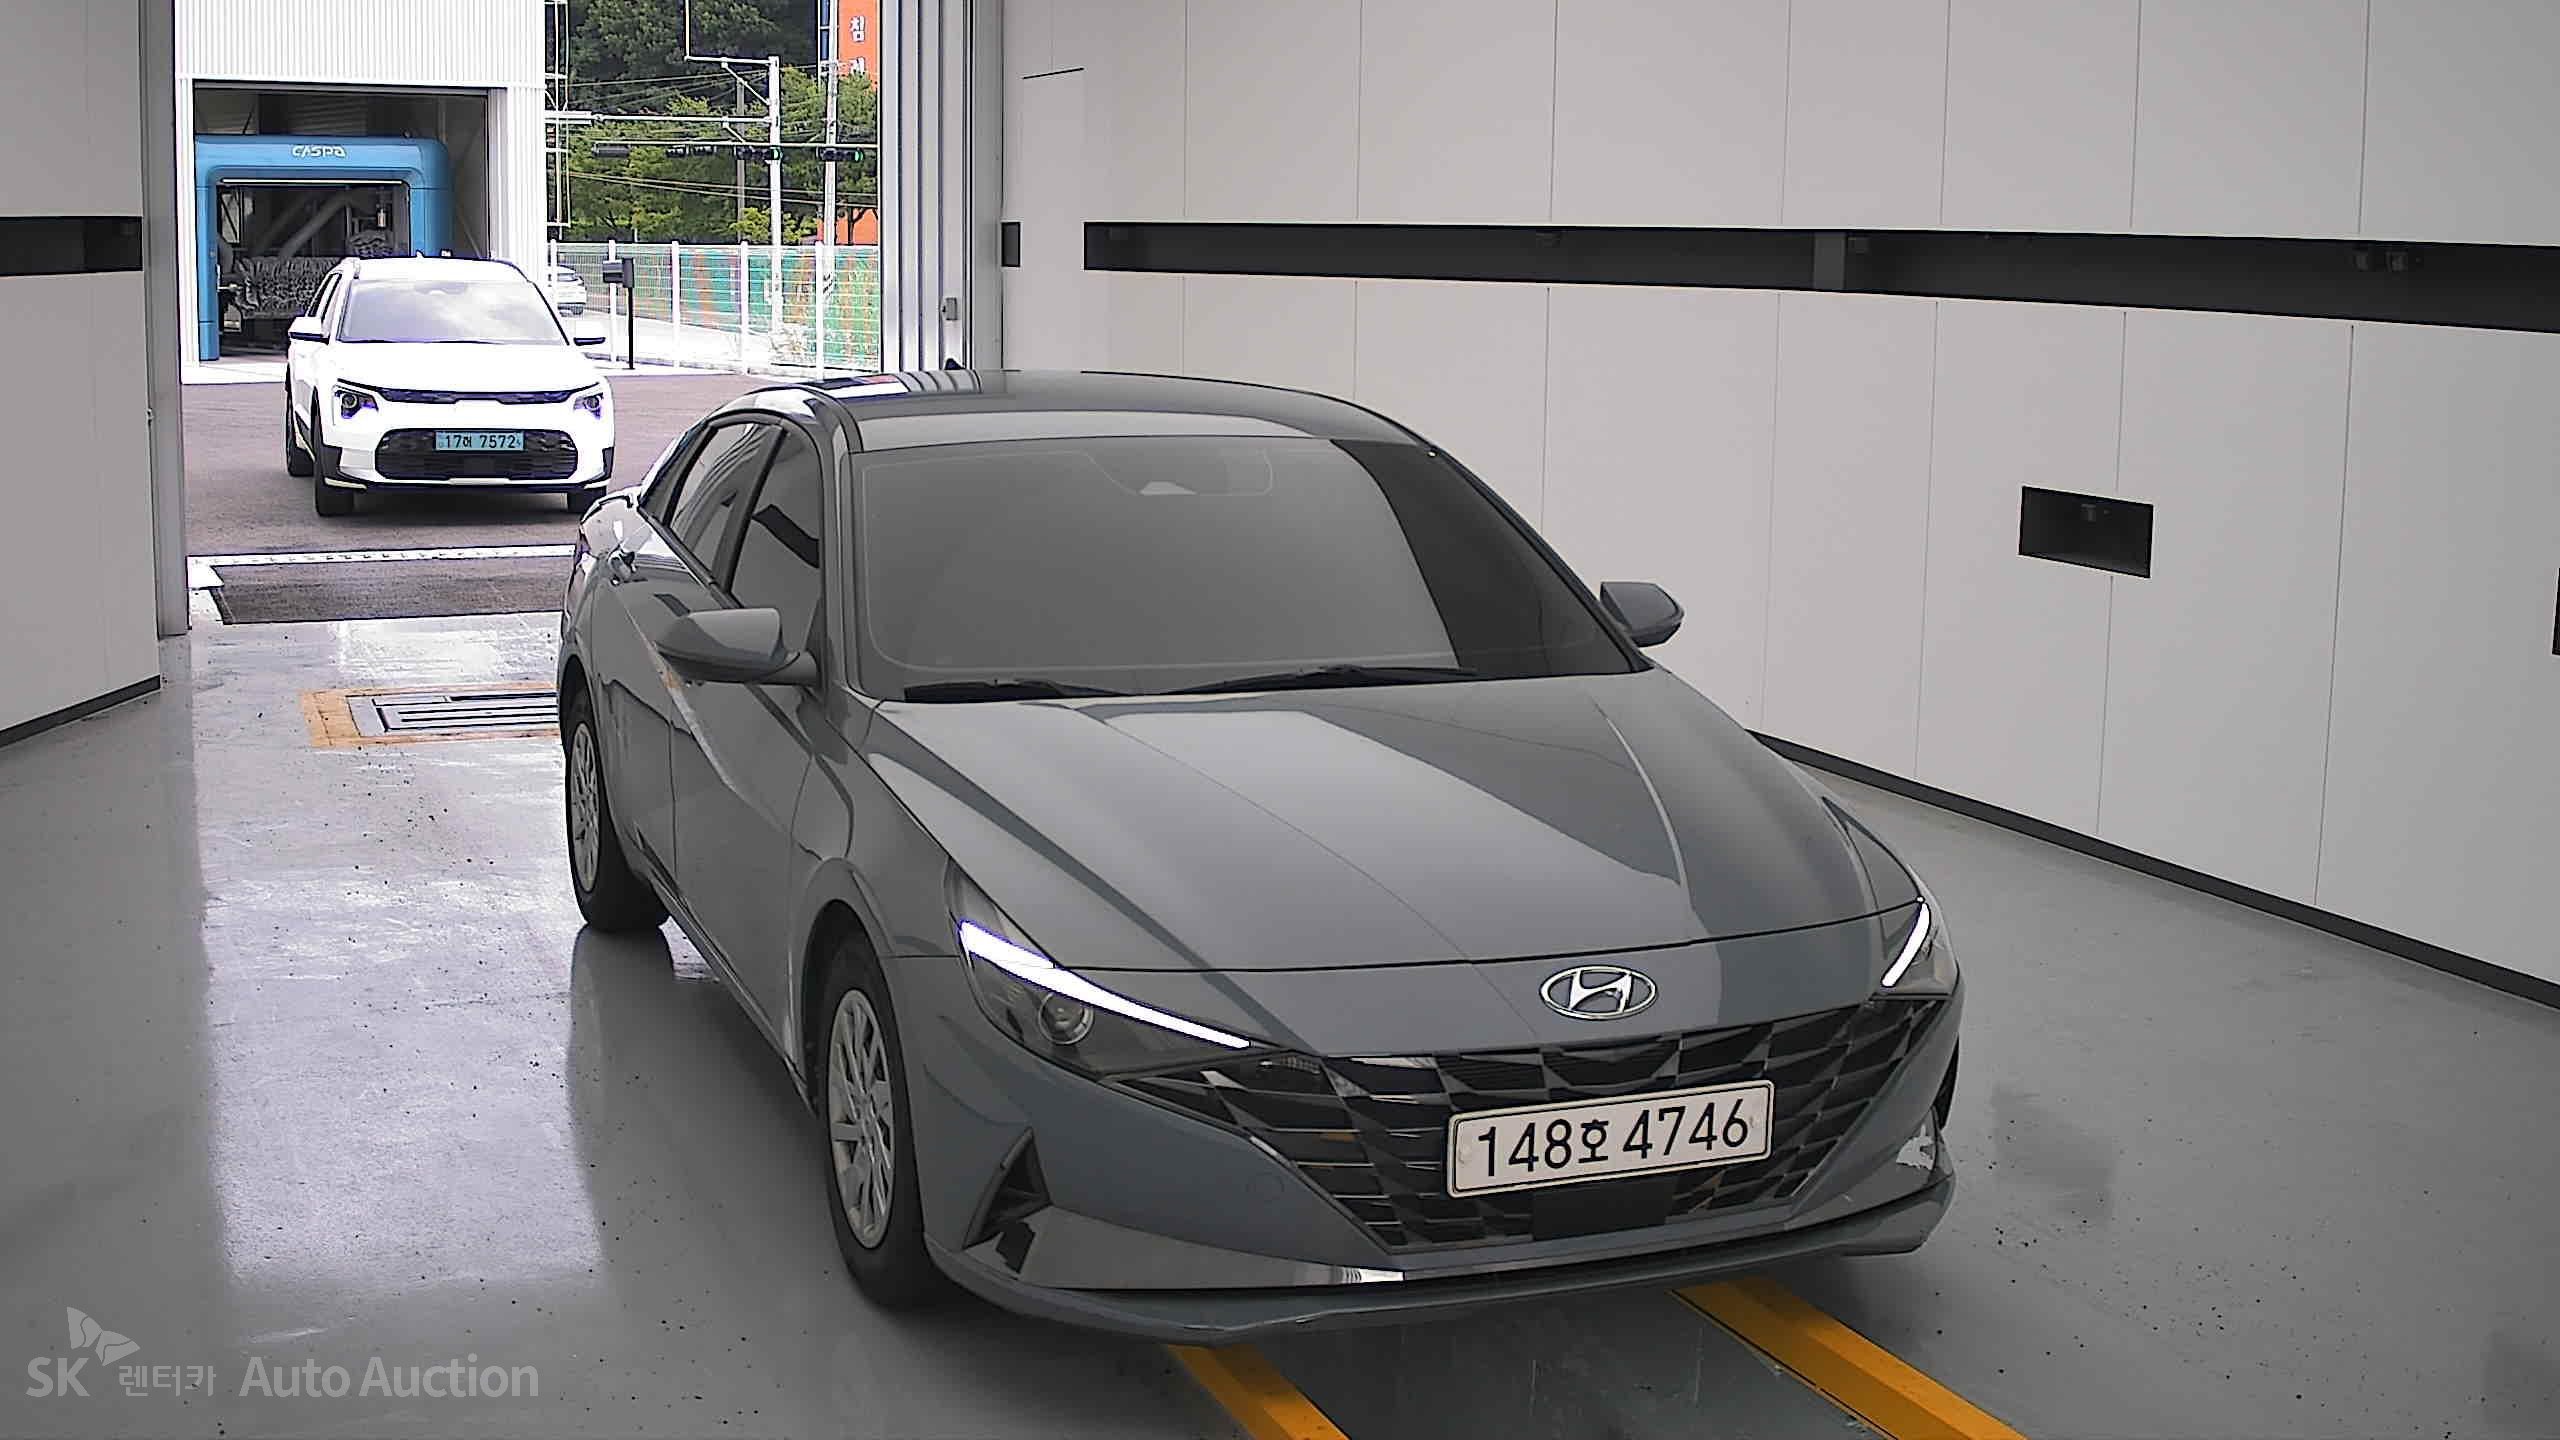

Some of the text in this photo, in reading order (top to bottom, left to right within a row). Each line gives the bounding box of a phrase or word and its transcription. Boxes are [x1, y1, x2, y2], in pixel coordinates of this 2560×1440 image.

[479, 434, 516, 449] 7572
[1477, 1098, 1749, 1177] 148호 4746
